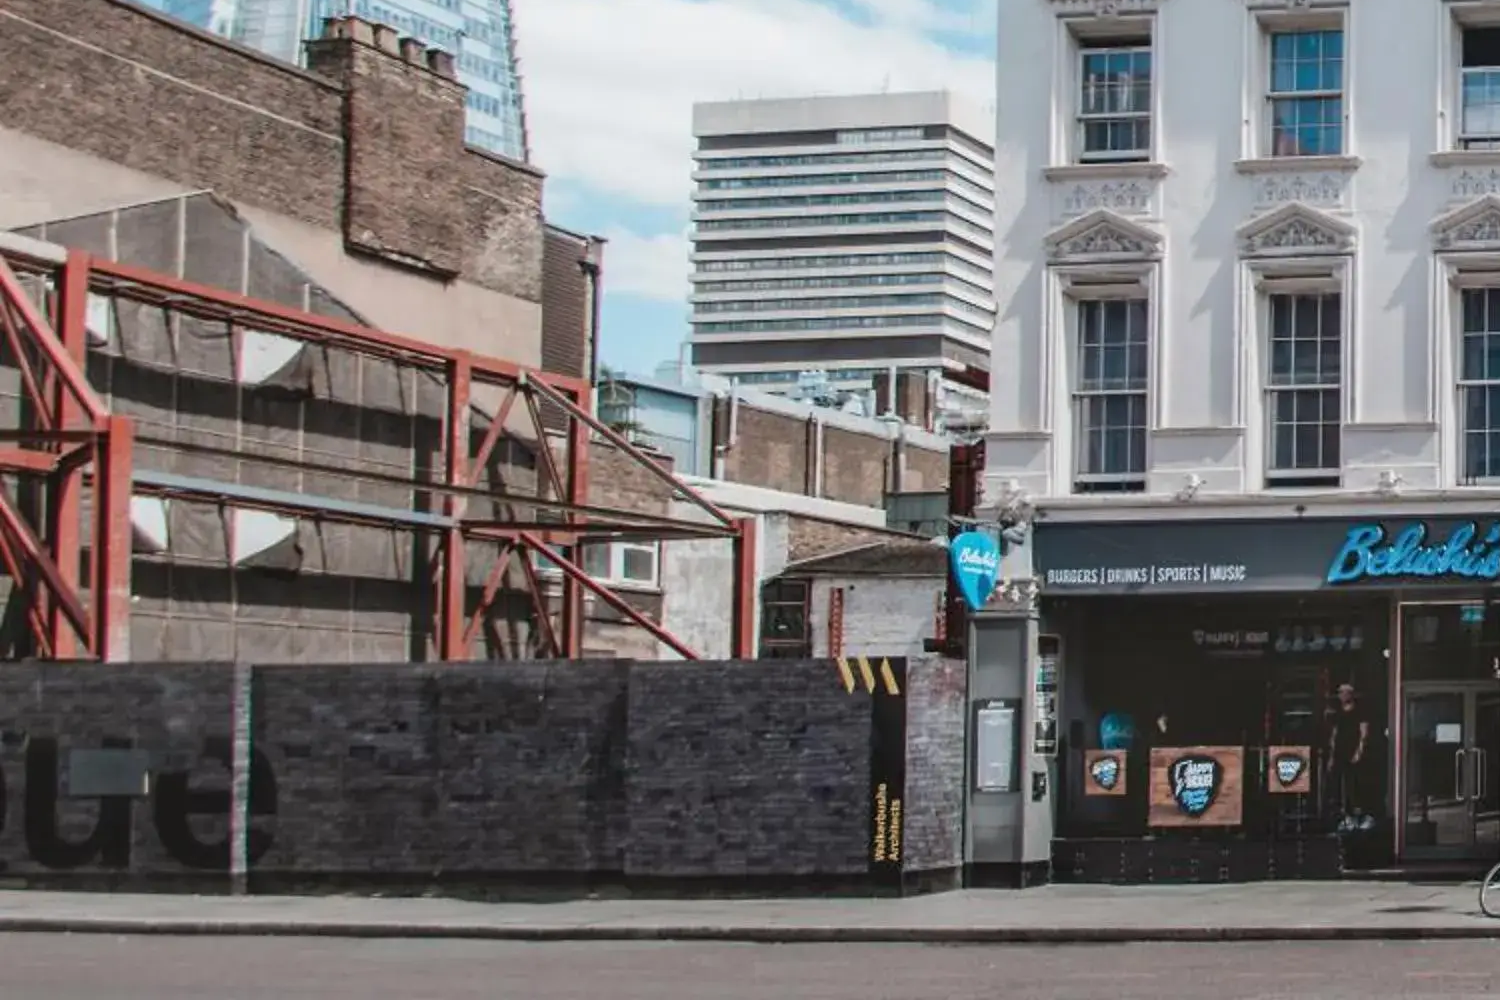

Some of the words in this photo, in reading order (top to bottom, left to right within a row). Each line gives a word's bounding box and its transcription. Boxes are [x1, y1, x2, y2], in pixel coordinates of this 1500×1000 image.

[1047, 568, 1098, 584] BURGERS
[1107, 567, 1148, 583] DRINKS
[1157, 566, 1201, 582] SPORTS
[1209, 564, 1247, 581] MUSIC
[889, 800, 901, 861] Architects
